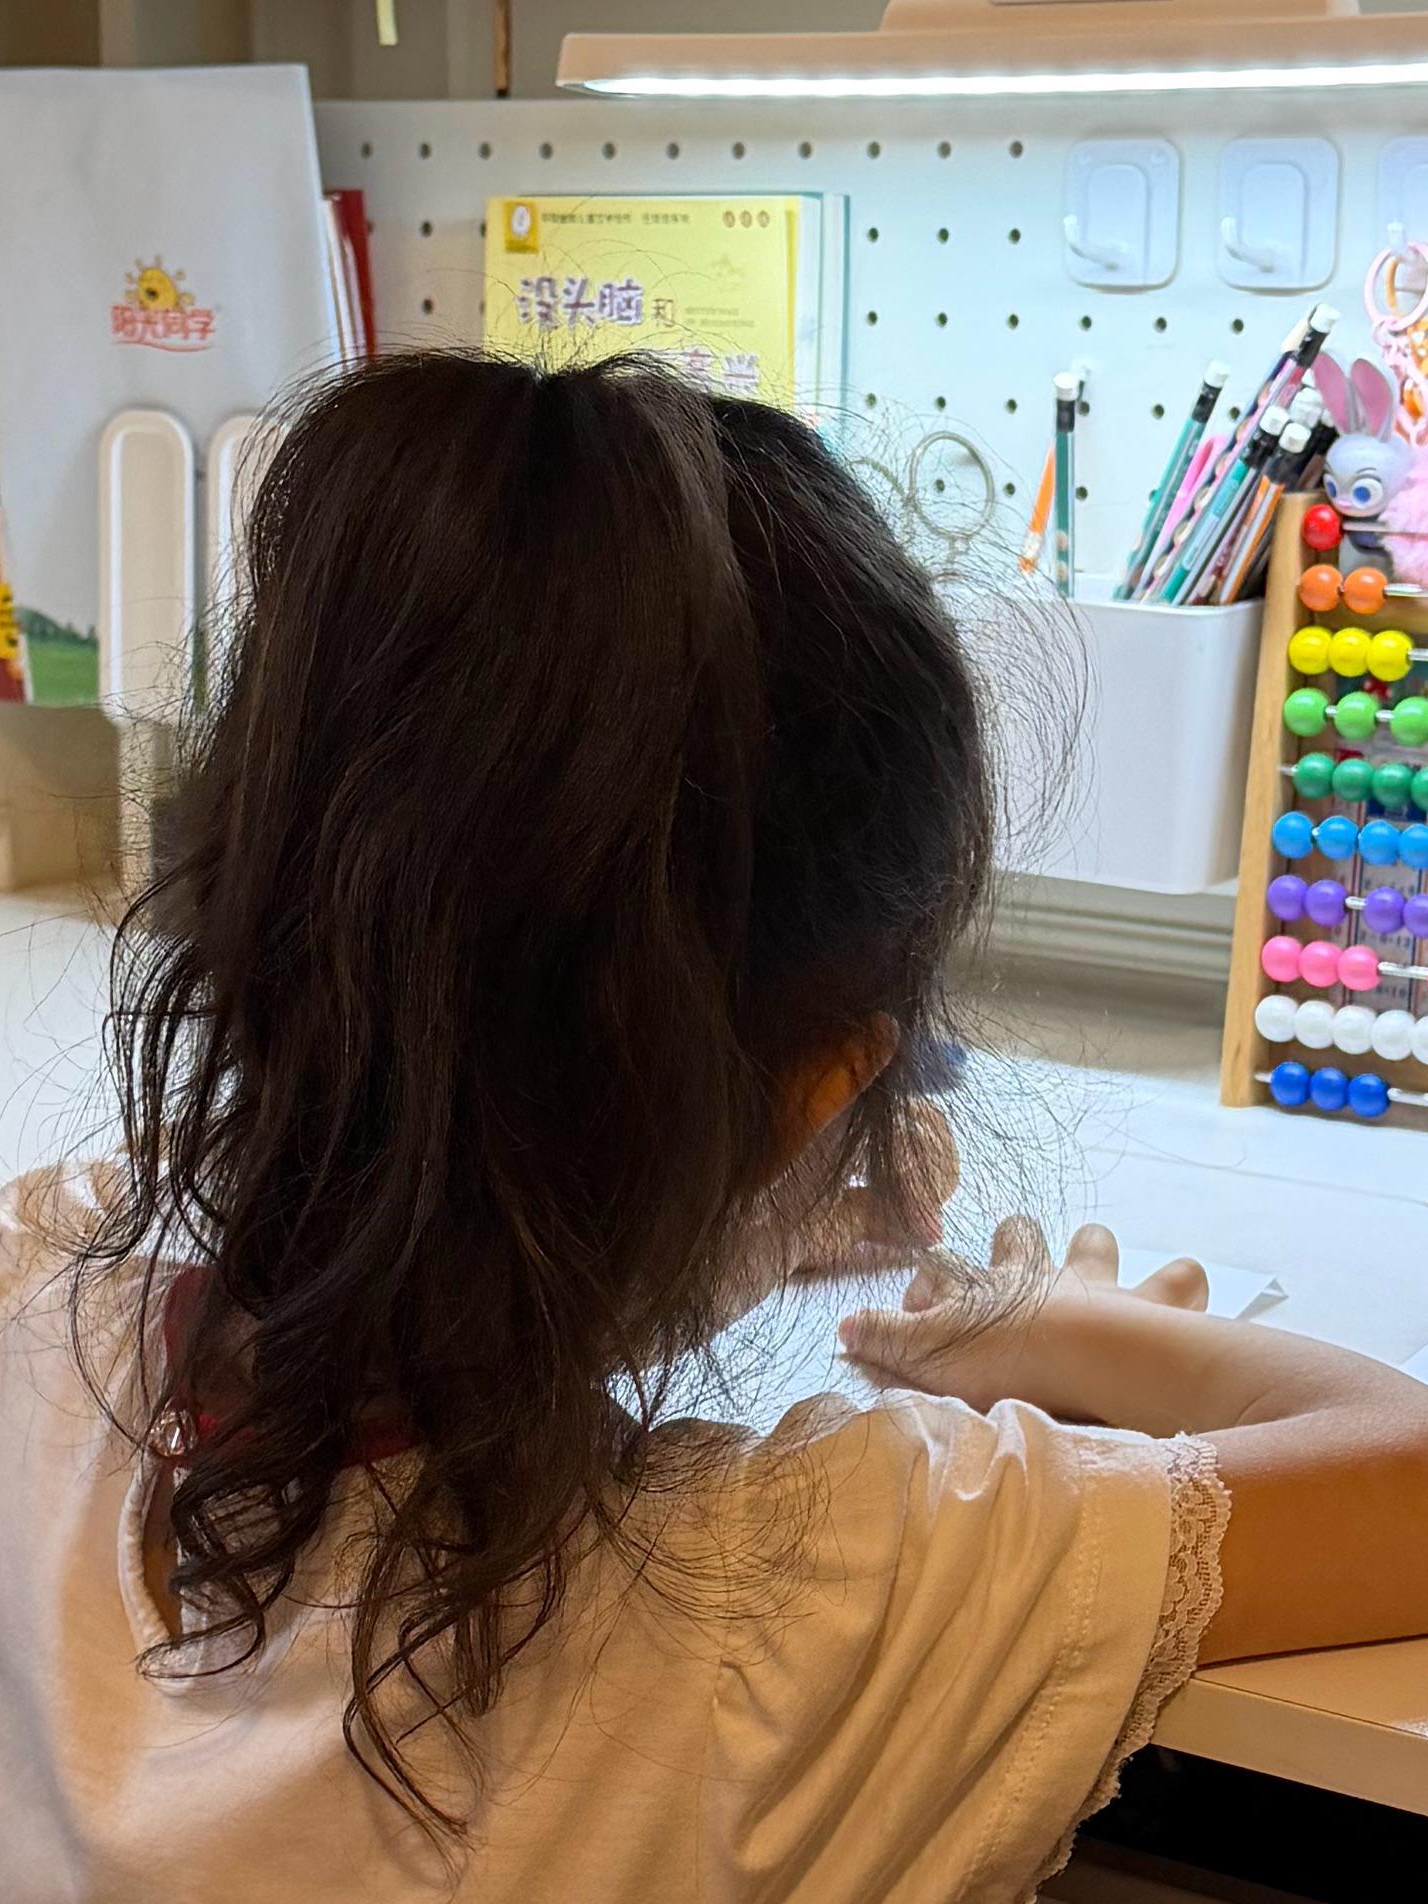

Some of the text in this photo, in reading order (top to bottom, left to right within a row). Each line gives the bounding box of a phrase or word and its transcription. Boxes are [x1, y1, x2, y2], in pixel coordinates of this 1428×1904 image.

[518, 276, 643, 329] 没头脑
[651, 298, 674, 328] 和
